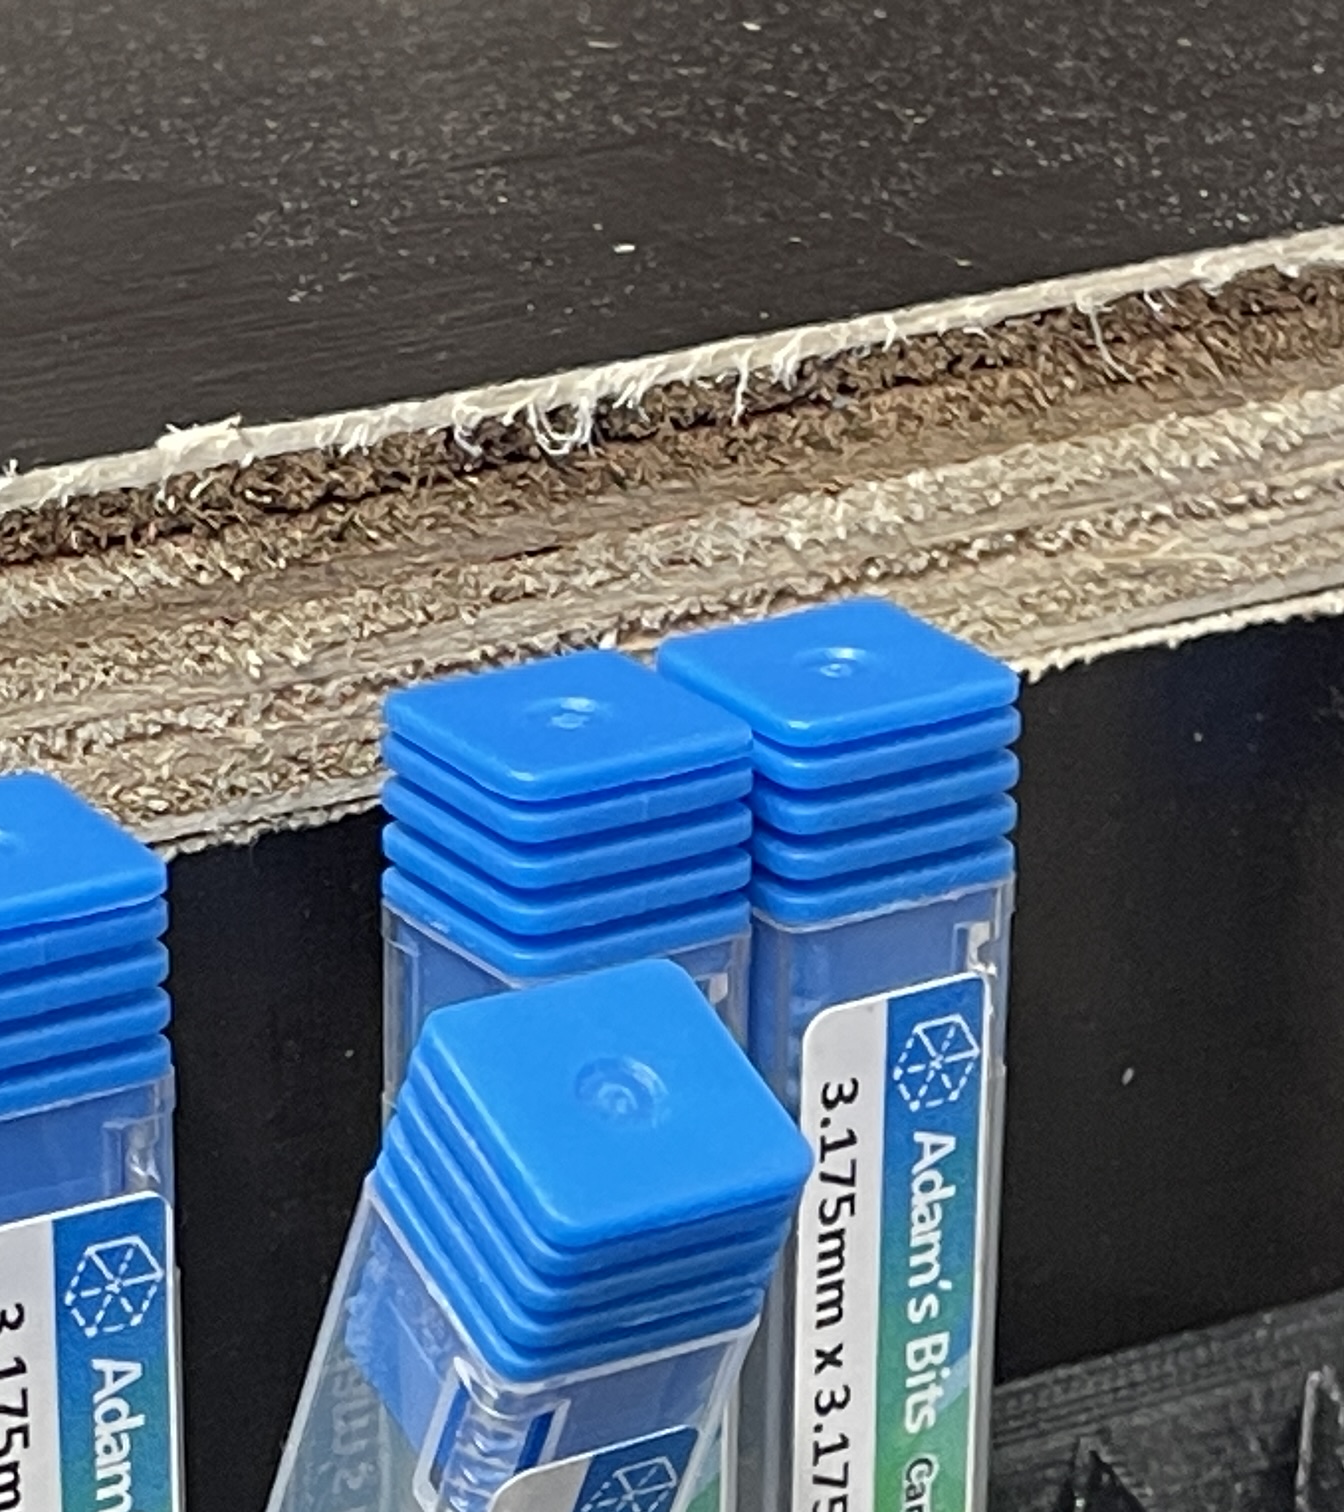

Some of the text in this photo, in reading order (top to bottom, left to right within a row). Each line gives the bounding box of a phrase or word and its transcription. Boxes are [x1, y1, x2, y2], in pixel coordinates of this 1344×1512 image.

[814, 1076, 860, 1330] 3.175mm
[907, 1130, 957, 1325] Adam's
[813, 1341, 844, 1374] x
[903, 1330, 951, 1434] Bits
